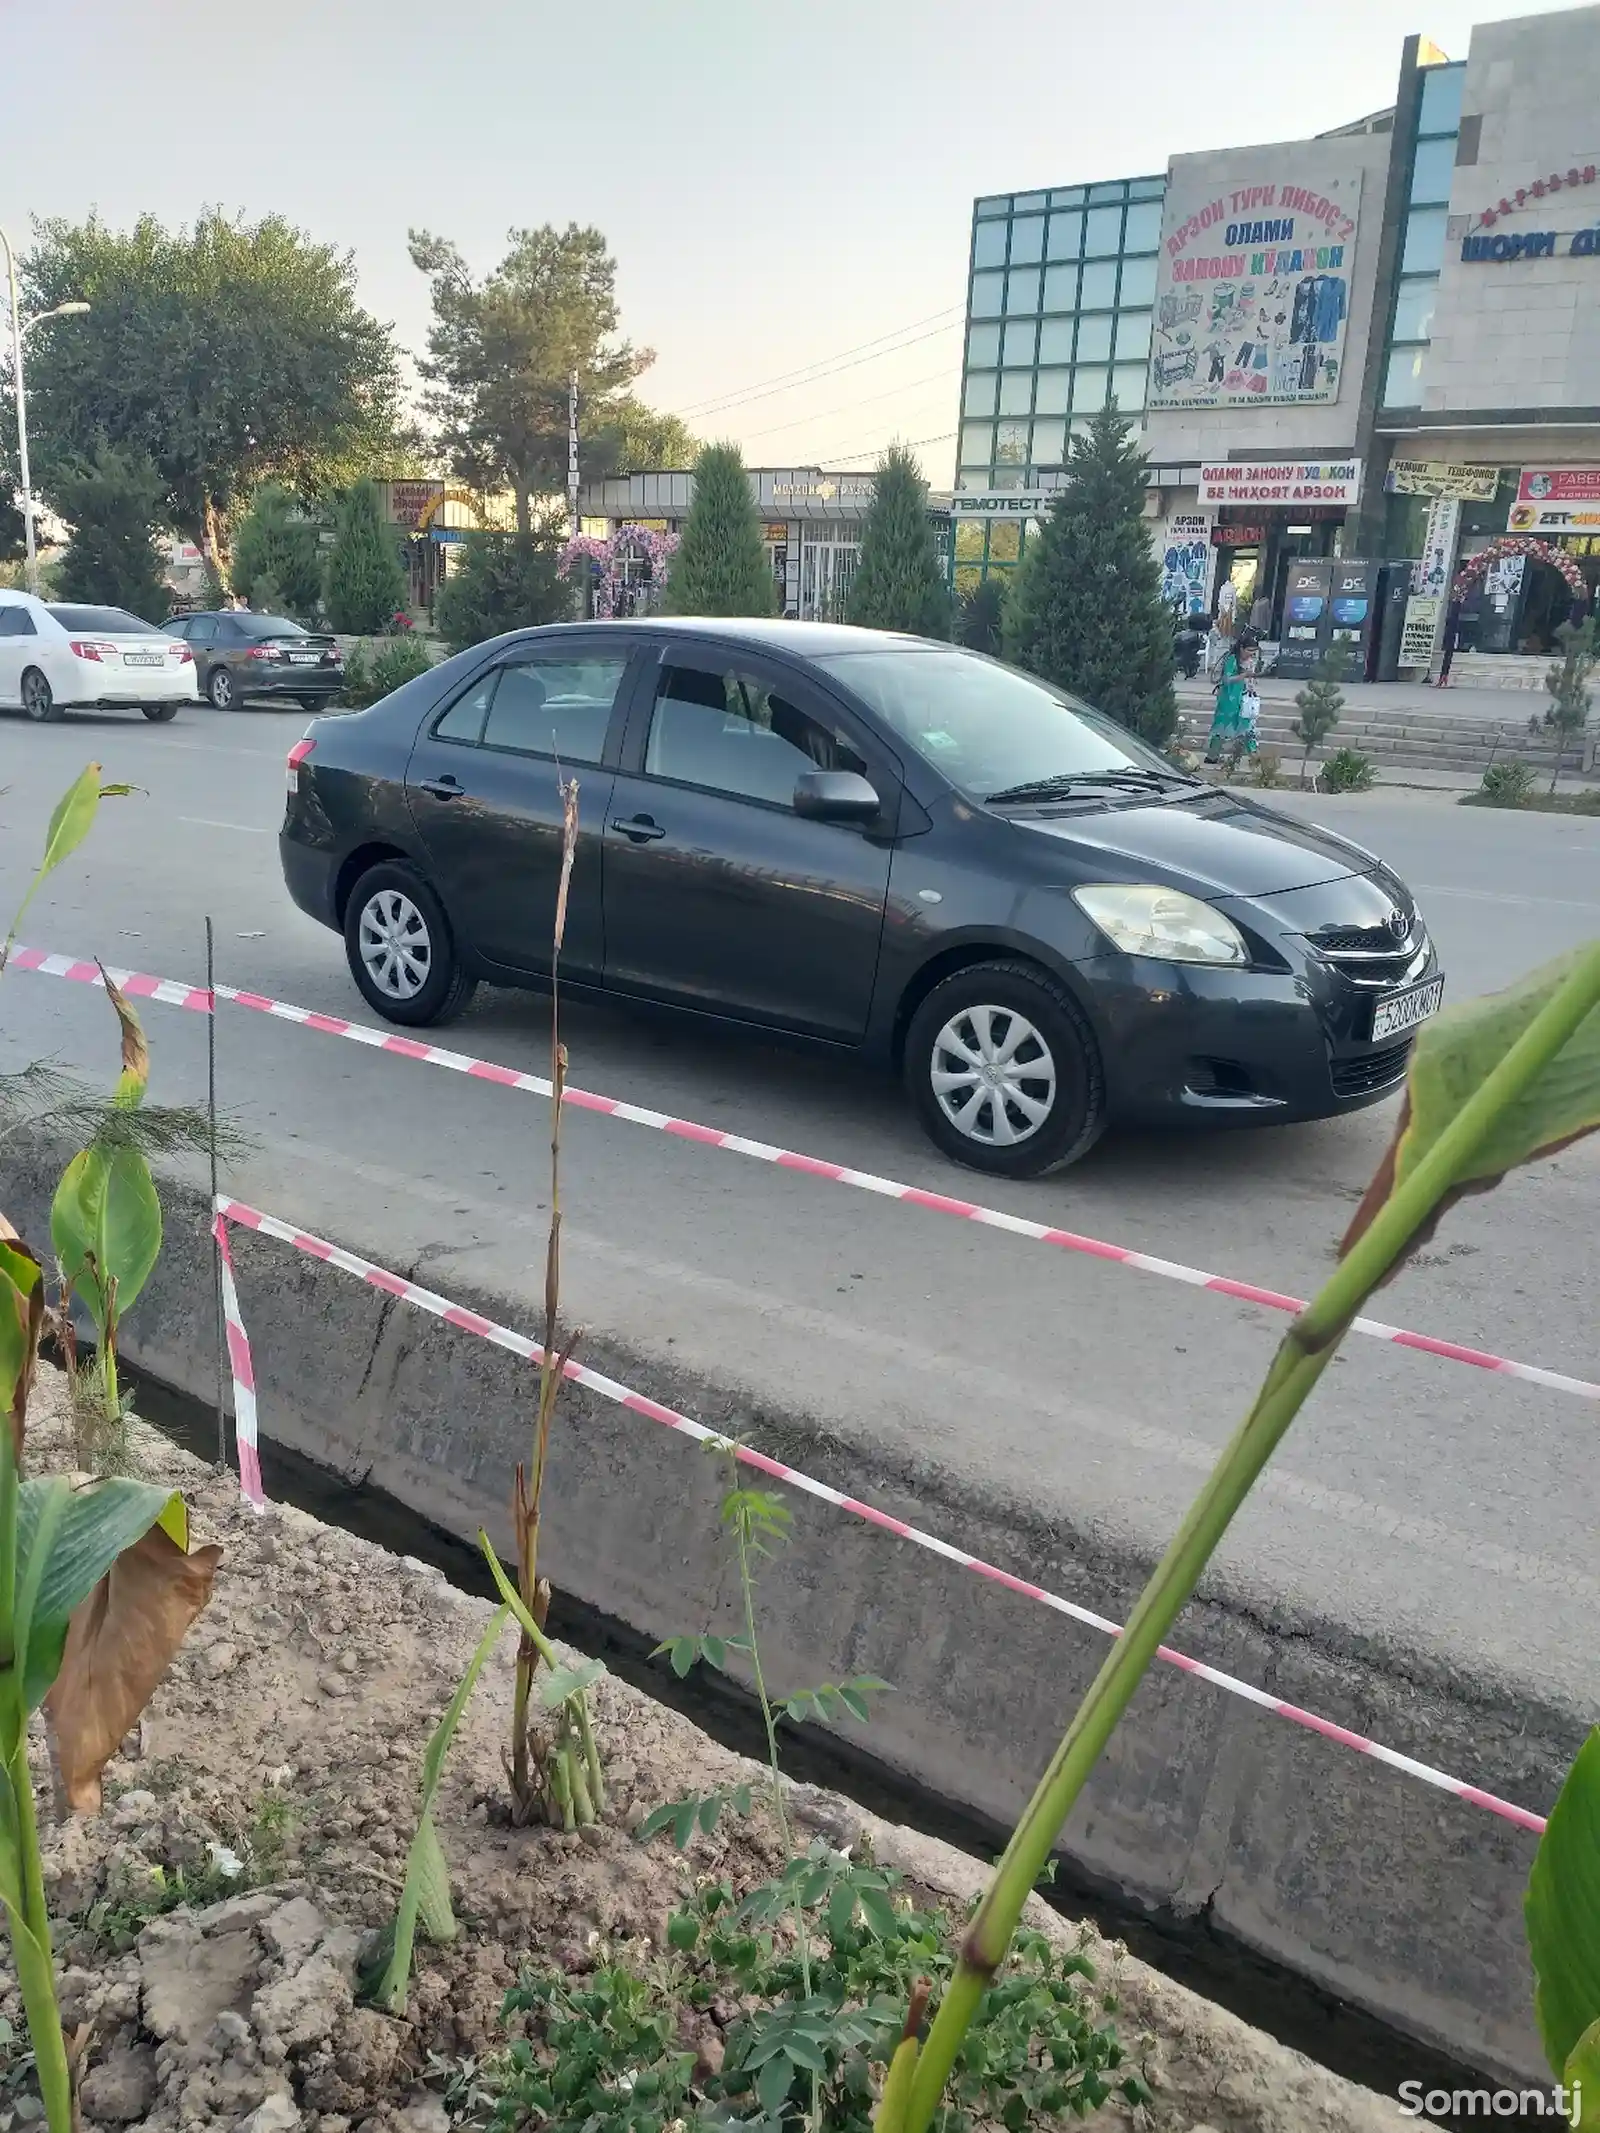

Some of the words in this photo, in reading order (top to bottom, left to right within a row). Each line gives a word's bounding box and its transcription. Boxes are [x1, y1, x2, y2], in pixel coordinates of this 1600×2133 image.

[1165, 198, 1224, 257] АРЗОН
[1279, 186, 1341, 228] ЛИБОС
[1225, 218, 1294, 246] ОЛАМИ
[1202, 467, 1243, 481] ОЛАМИ
[1246, 466, 1293, 481] ЗАНОНУ
[1207, 487, 1225, 499] БЕ
[1293, 486, 1346, 498] АРЗОН
